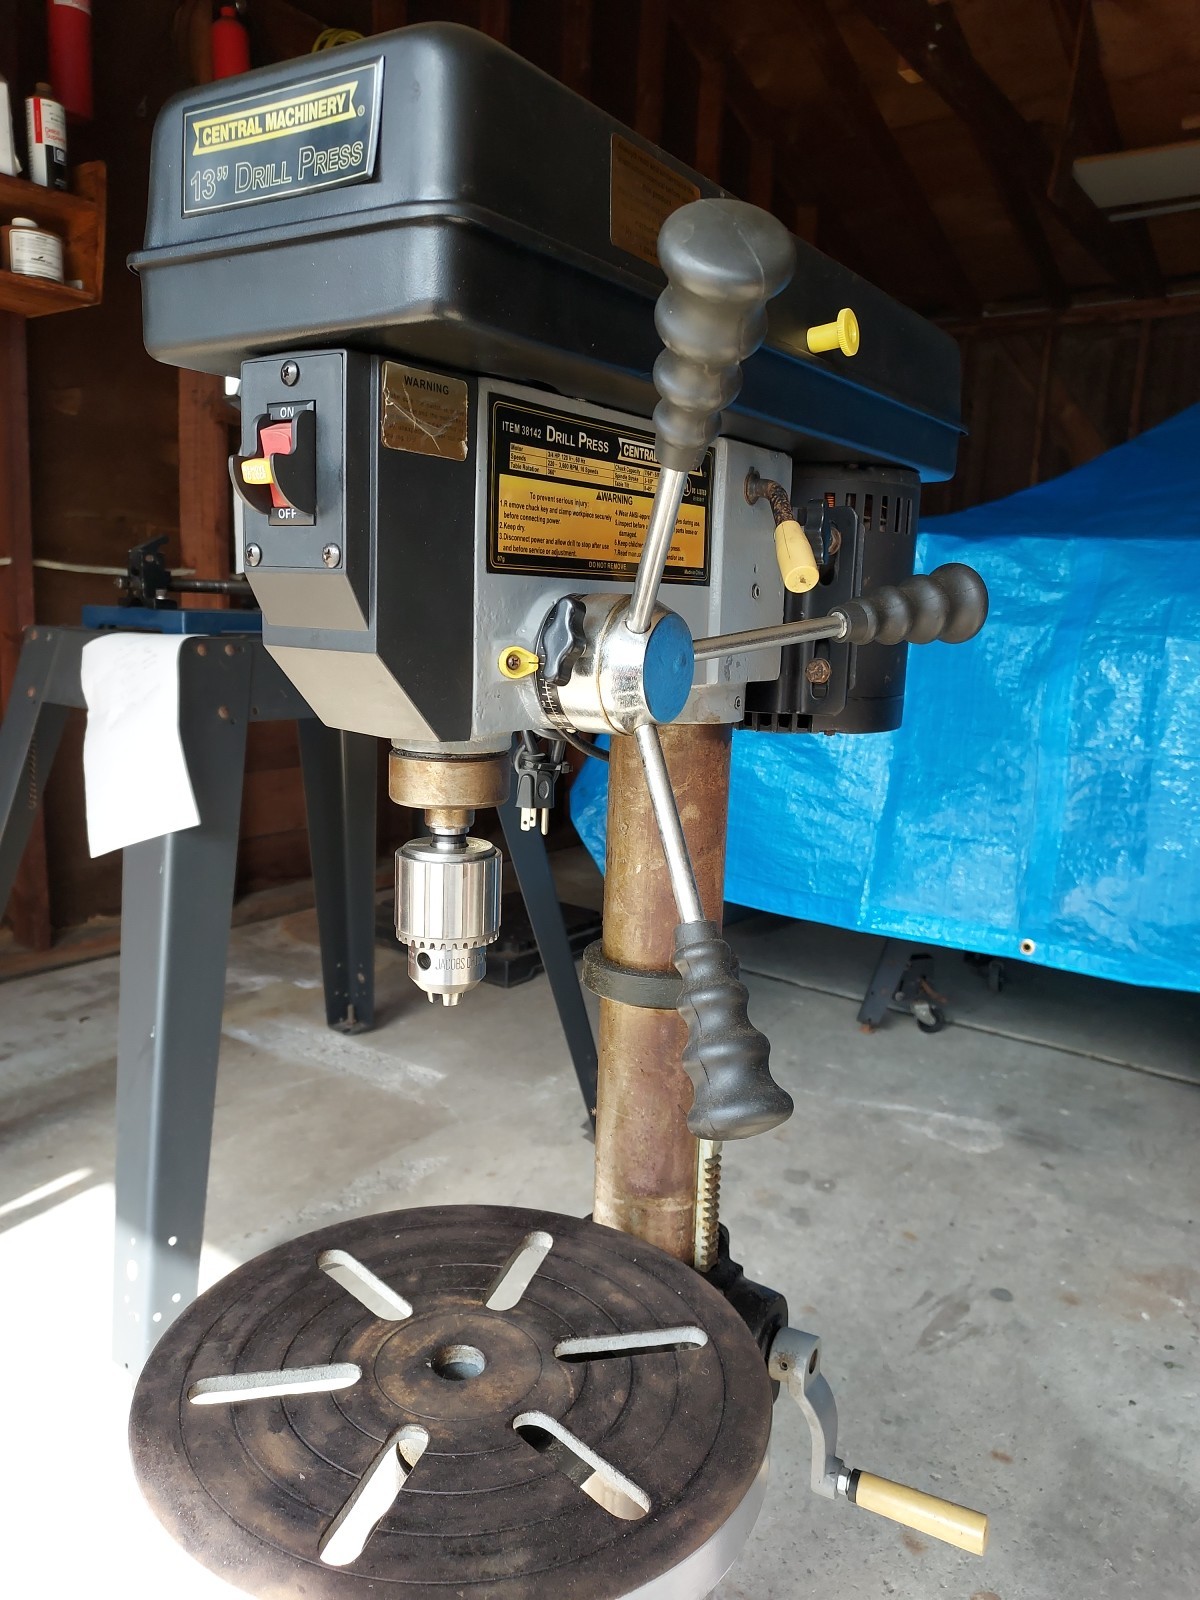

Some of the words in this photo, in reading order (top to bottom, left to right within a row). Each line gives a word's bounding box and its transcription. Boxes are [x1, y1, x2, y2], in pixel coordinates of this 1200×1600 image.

[202, 115, 262, 145] CENTRAL
[266, 93, 346, 132] MACHINERY
[404, 375, 449, 395] WARNING
[280, 407, 294, 418] ON
[502, 420, 520, 434] ITEM
[521, 425, 542, 439] 38142
[511, 452, 526, 462] Speeds
[510, 461, 521, 470] Table
[530, 491, 536, 500] To
[536, 494, 556, 503] prevent
[556, 496, 574, 505] serious
[601, 491, 633, 506] WARNING
[278, 508, 296, 519] OFF
[503, 511, 519, 520] before
[519, 514, 546, 525] connecting
[525, 503, 540, 512] chuck
[540, 505, 549, 515] key
[558, 508, 572, 517] clamp
[572, 510, 594, 519] workpiece
[594, 513, 612, 523] securely
[502, 544, 512, 552] and
[512, 545, 528, 553] before
[530, 536, 545, 545] power
[554, 538, 567, 546] allow
[567, 539, 575, 547] drill
[581, 541, 591, 550] stop
[591, 541, 601, 549] after
[588, 560, 596, 569] DO
[596, 561, 607, 570] NOT
[607, 562, 627, 571] REMOVE
